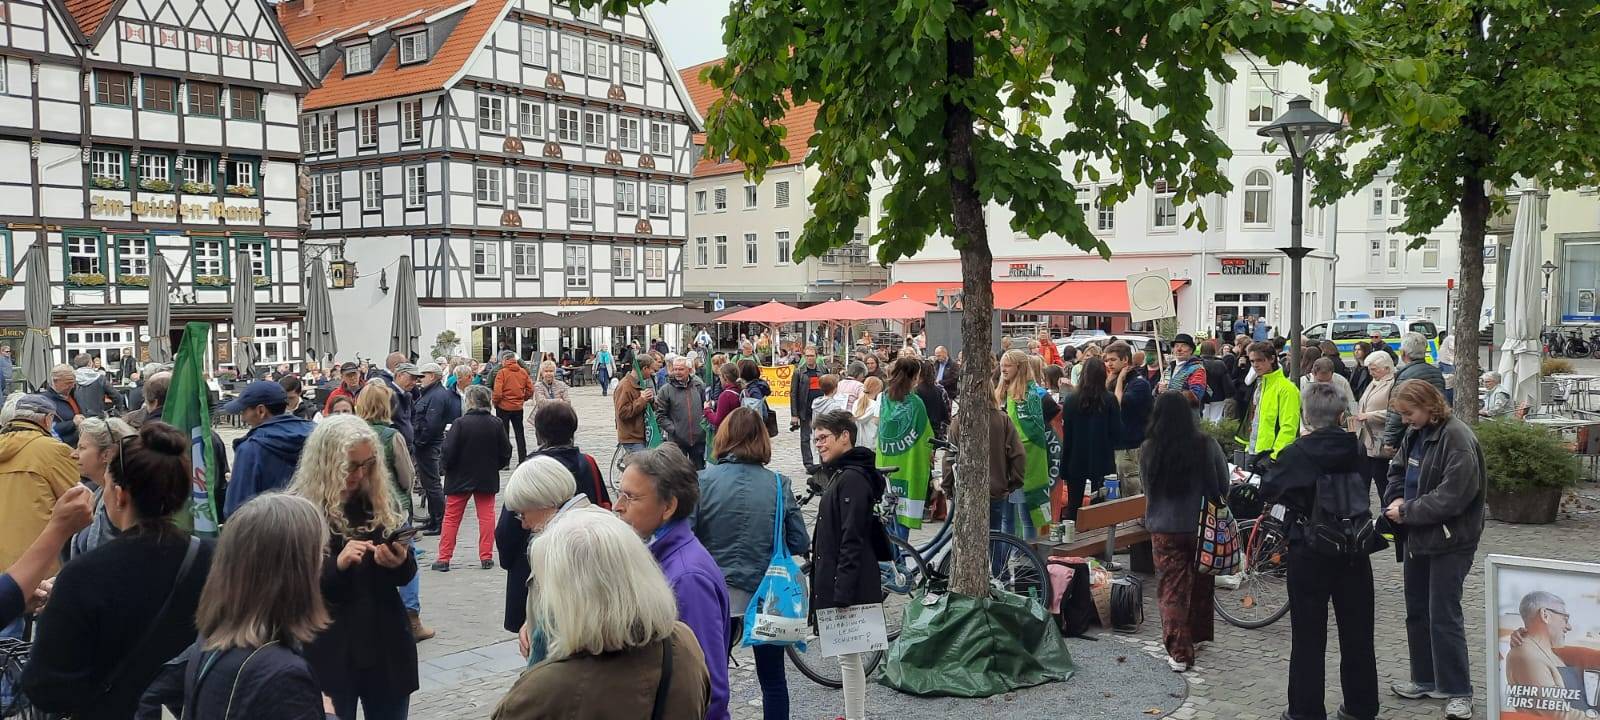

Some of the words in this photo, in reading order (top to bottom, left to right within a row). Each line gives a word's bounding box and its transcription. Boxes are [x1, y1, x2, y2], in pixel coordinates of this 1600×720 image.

[92, 195, 125, 217] Im
[132, 196, 203, 220] wilden
[208, 201, 263, 221] Mann
[1222, 259, 1270, 275] extrablatt
[881, 428, 919, 454] UTURE
[1044, 430, 1061, 454] AYS
[1506, 684, 1538, 697] MEHR
[1541, 685, 1581, 700] WÜRZE
[1506, 695, 1534, 709] FÜRS
[1536, 699, 1571, 712] LEBEN
